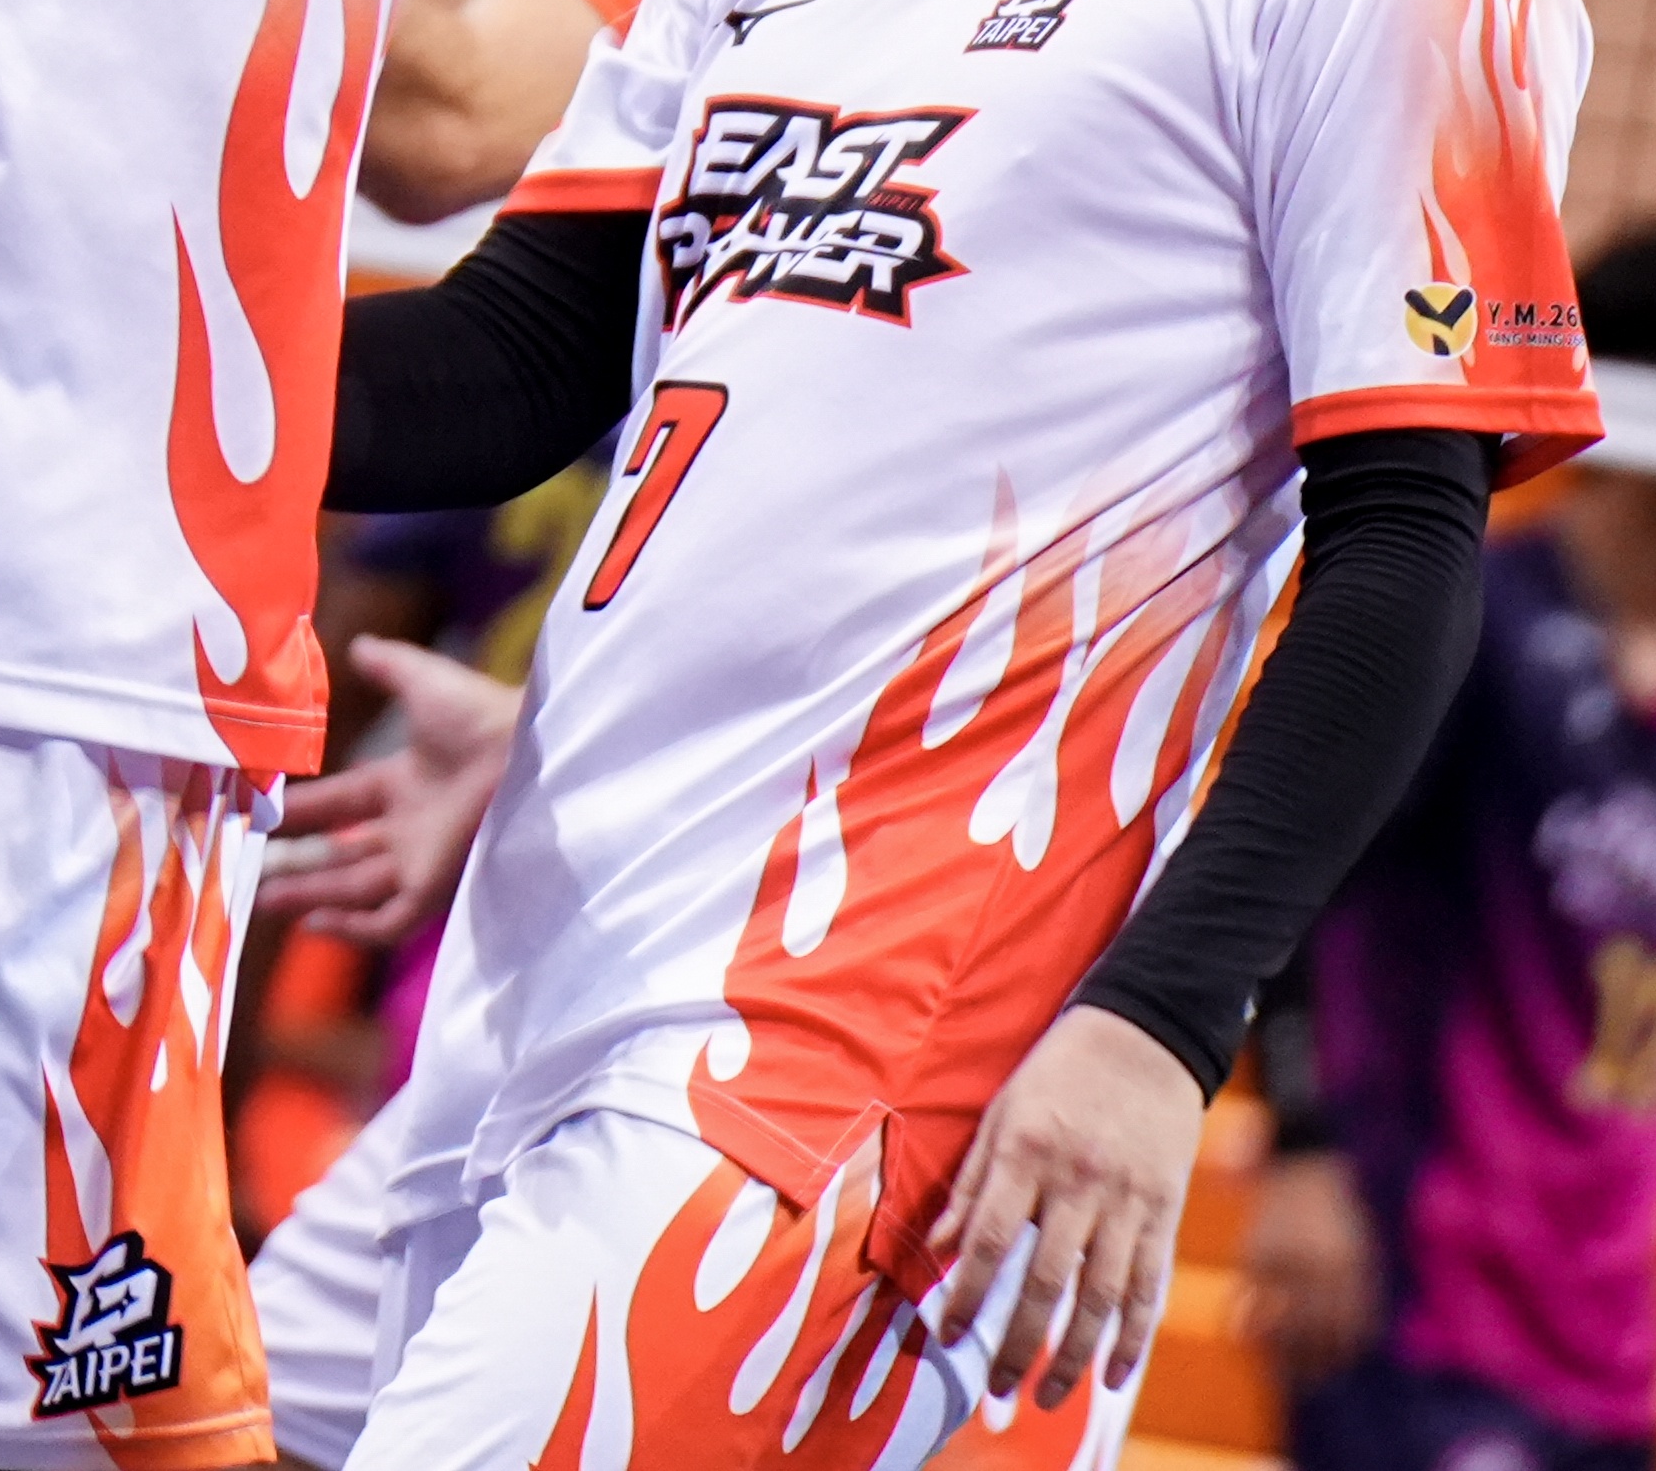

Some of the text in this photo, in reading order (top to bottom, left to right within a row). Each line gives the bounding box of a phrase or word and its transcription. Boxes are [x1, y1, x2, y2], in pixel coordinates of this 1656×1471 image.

[971, 16, 1059, 45] TAIPEI
[690, 111, 945, 201] EAST
[583, 379, 729, 611] 7
[41, 1331, 176, 1407] TAIPEI
